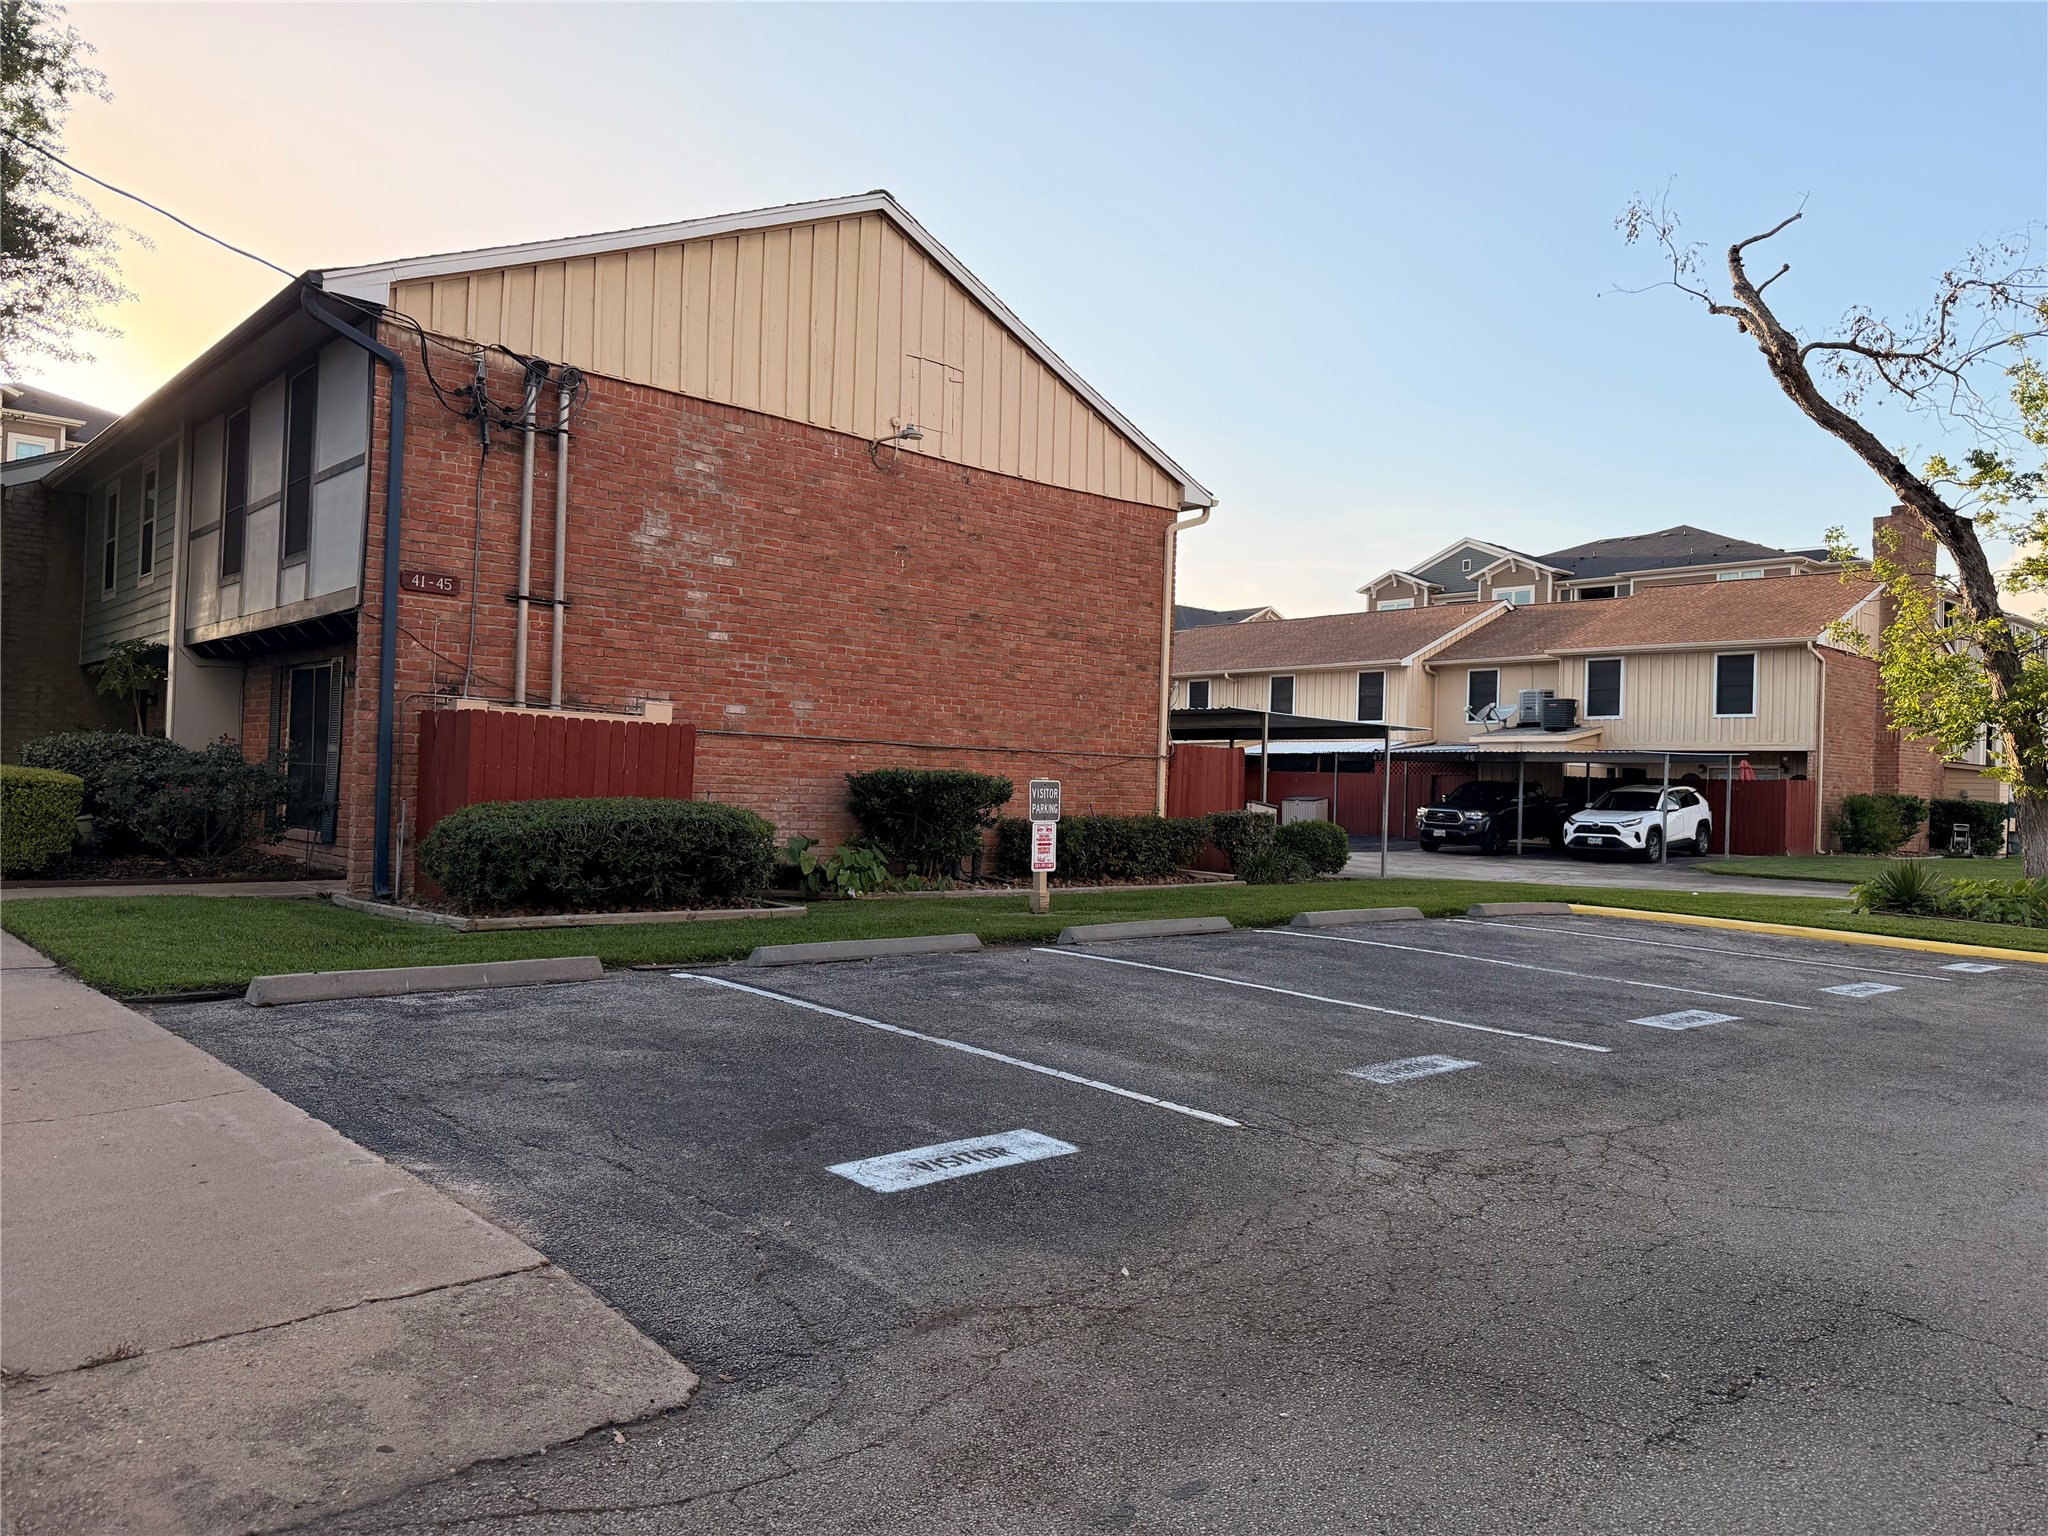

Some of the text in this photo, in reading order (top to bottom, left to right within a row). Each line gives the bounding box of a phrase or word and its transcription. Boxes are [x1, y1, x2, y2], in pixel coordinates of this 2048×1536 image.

[1372, 753, 1383, 761] 47
[1464, 753, 1476, 762] 46
[1031, 788, 1059, 799] VISITOR
[1031, 803, 1059, 814] PARKING
[909, 1146, 1017, 1172] VISITOR
